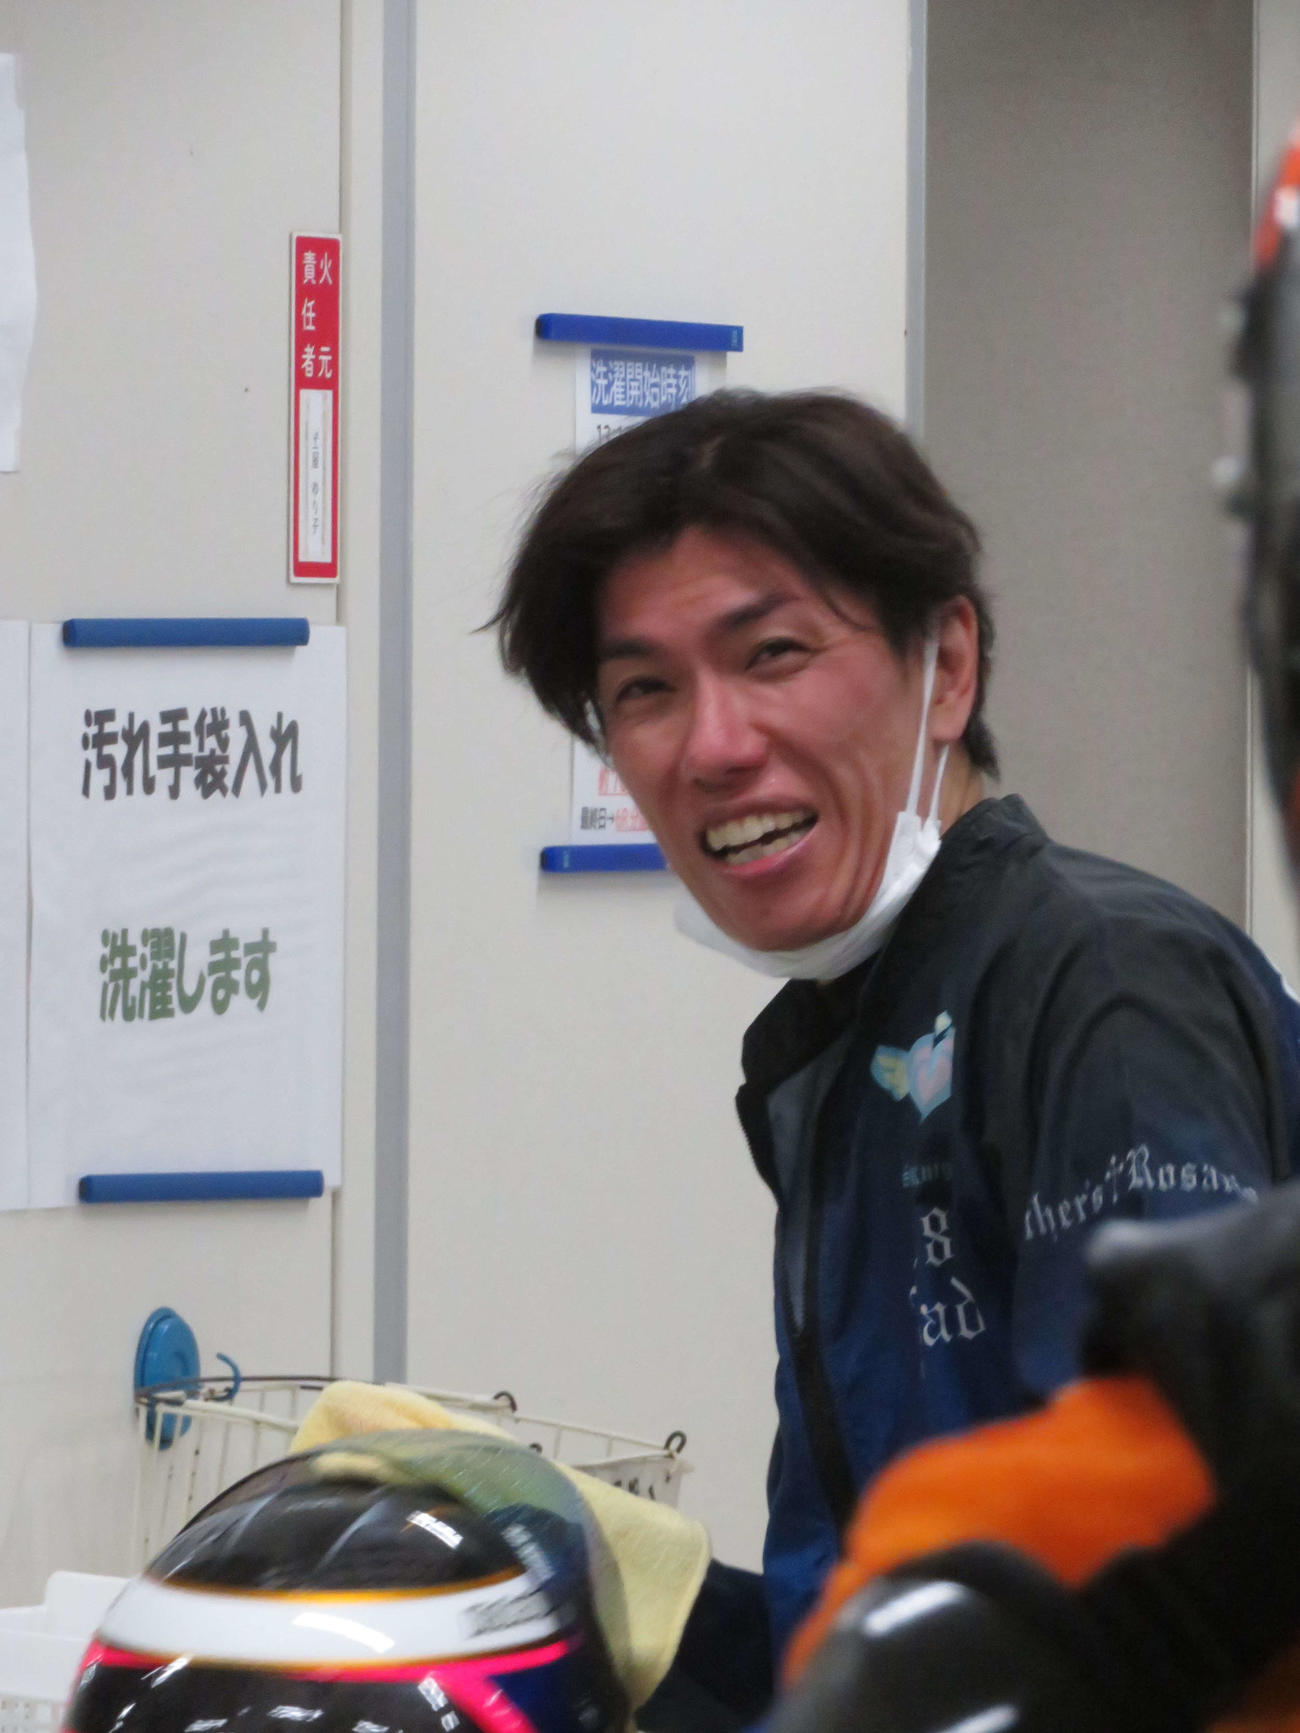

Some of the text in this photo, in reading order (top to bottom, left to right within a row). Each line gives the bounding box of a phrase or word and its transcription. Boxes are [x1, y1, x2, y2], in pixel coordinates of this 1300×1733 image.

[301, 250, 317, 378] 責任者
[318, 252, 333, 379] 火元
[592, 360, 696, 408] 洗濯開始時刻
[82, 706, 303, 800] 汚れ手袋入れ
[100, 927, 277, 1022] 洗濯します
